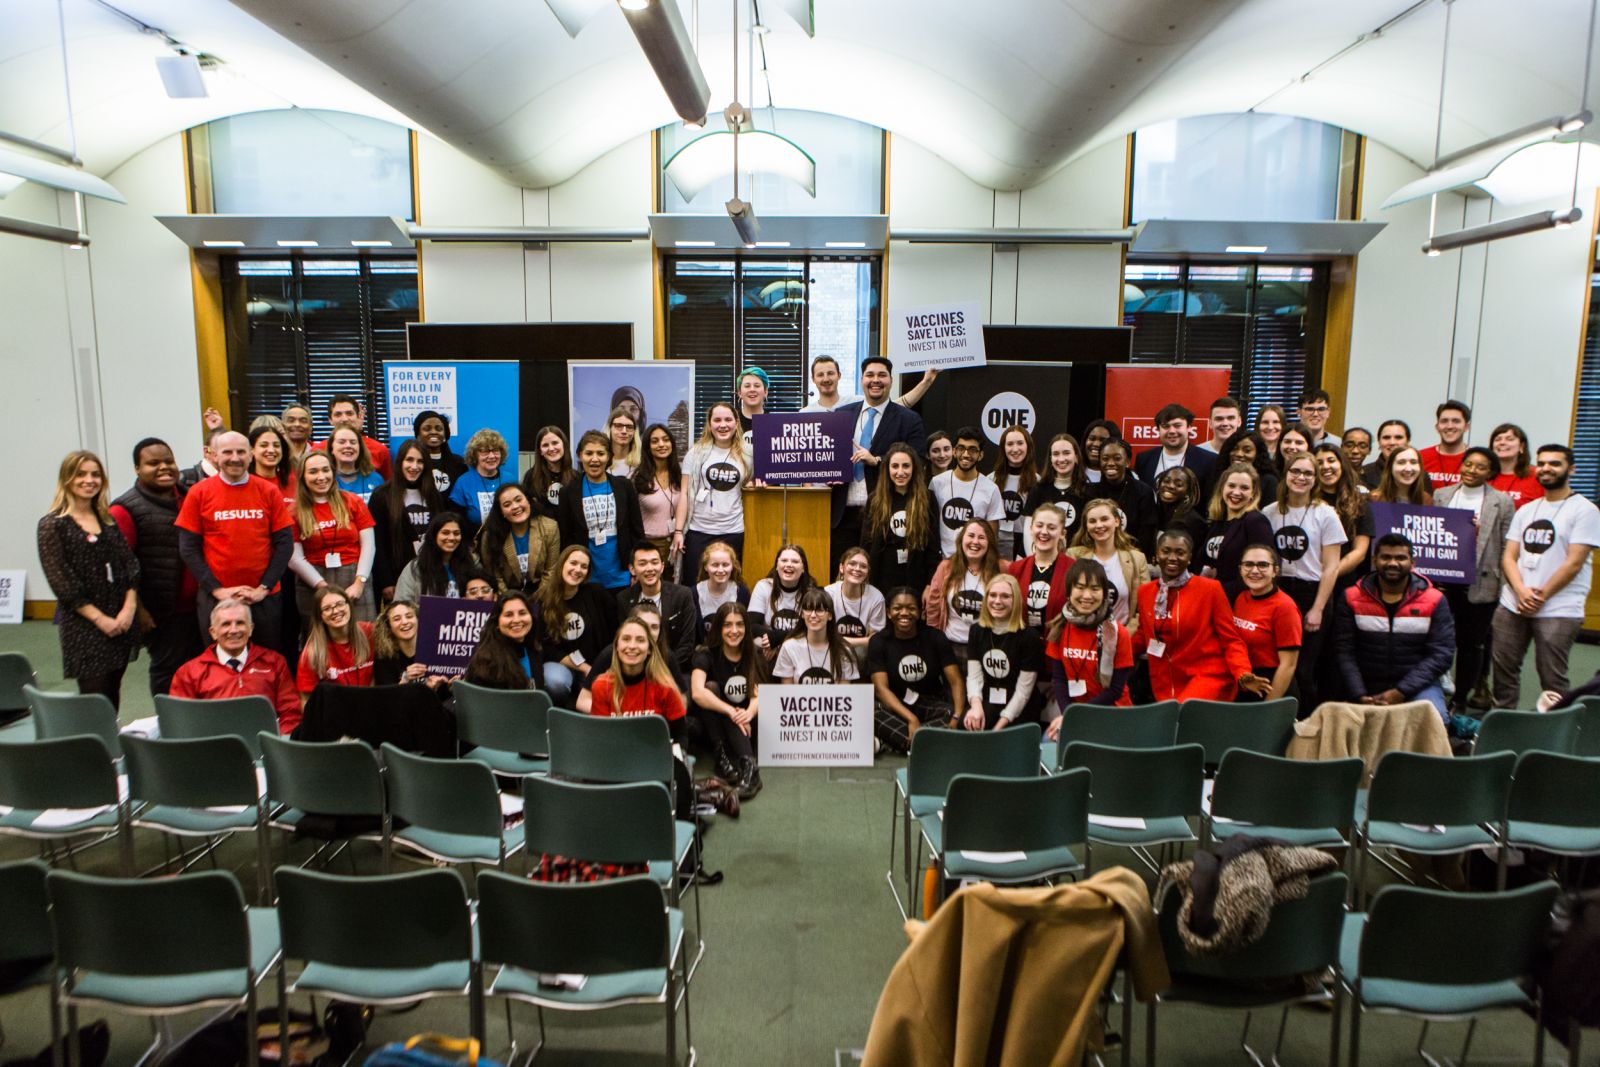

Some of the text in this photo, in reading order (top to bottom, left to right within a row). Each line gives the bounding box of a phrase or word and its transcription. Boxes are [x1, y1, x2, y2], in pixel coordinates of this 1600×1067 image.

[906, 311, 964, 328] VACCINES
[907, 326, 966, 340] SAVE LIVES:
[908, 338, 967, 352] INVEST IN GAVI
[904, 355, 975, 367] #PROTECTTHENEXTGENERATION
[392, 371, 452, 380] FOR EVERY
[392, 383, 441, 392] CHILD IN
[393, 395, 439, 404] DANGER
[394, 413, 415, 426] uni
[988, 408, 1030, 428] ONE
[783, 423, 822, 437] PRIME
[1133, 426, 1198, 439] RESS
[771, 435, 835, 450] MINISTER:
[771, 451, 835, 463] INVEST IN GAVI
[709, 467, 738, 483] ONE
[765, 471, 842, 479] #PROTECTTHENEXTGENERATION
[1428, 472, 1462, 482] RESULT
[945, 505, 971, 521] ONE
[1005, 500, 1020, 513] NE
[214, 509, 263, 521] RESULTS
[893, 519, 906, 528] ON
[1404, 515, 1445, 532] PRIME
[1276, 534, 1305, 550] ONE
[1524, 527, 1554, 545] ONE
[1425, 547, 1437, 558] IN
[1437, 547, 1458, 560] GAVI
[1028, 589, 1049, 599] ONE
[455, 611, 491, 627] PRIM
[439, 624, 481, 642] MINIS
[568, 622, 582, 631] NE
[838, 624, 862, 637] ONE
[437, 643, 474, 657] INVEST
[1063, 647, 1098, 661] RESULT
[902, 662, 924, 675] ONE
[987, 657, 1006, 670] ONE
[727, 684, 747, 695] ONE
[780, 696, 852, 712] VACCINES
[780, 714, 852, 727] SAVE LIVES:
[780, 730, 852, 742] INVEST IN GAVI
